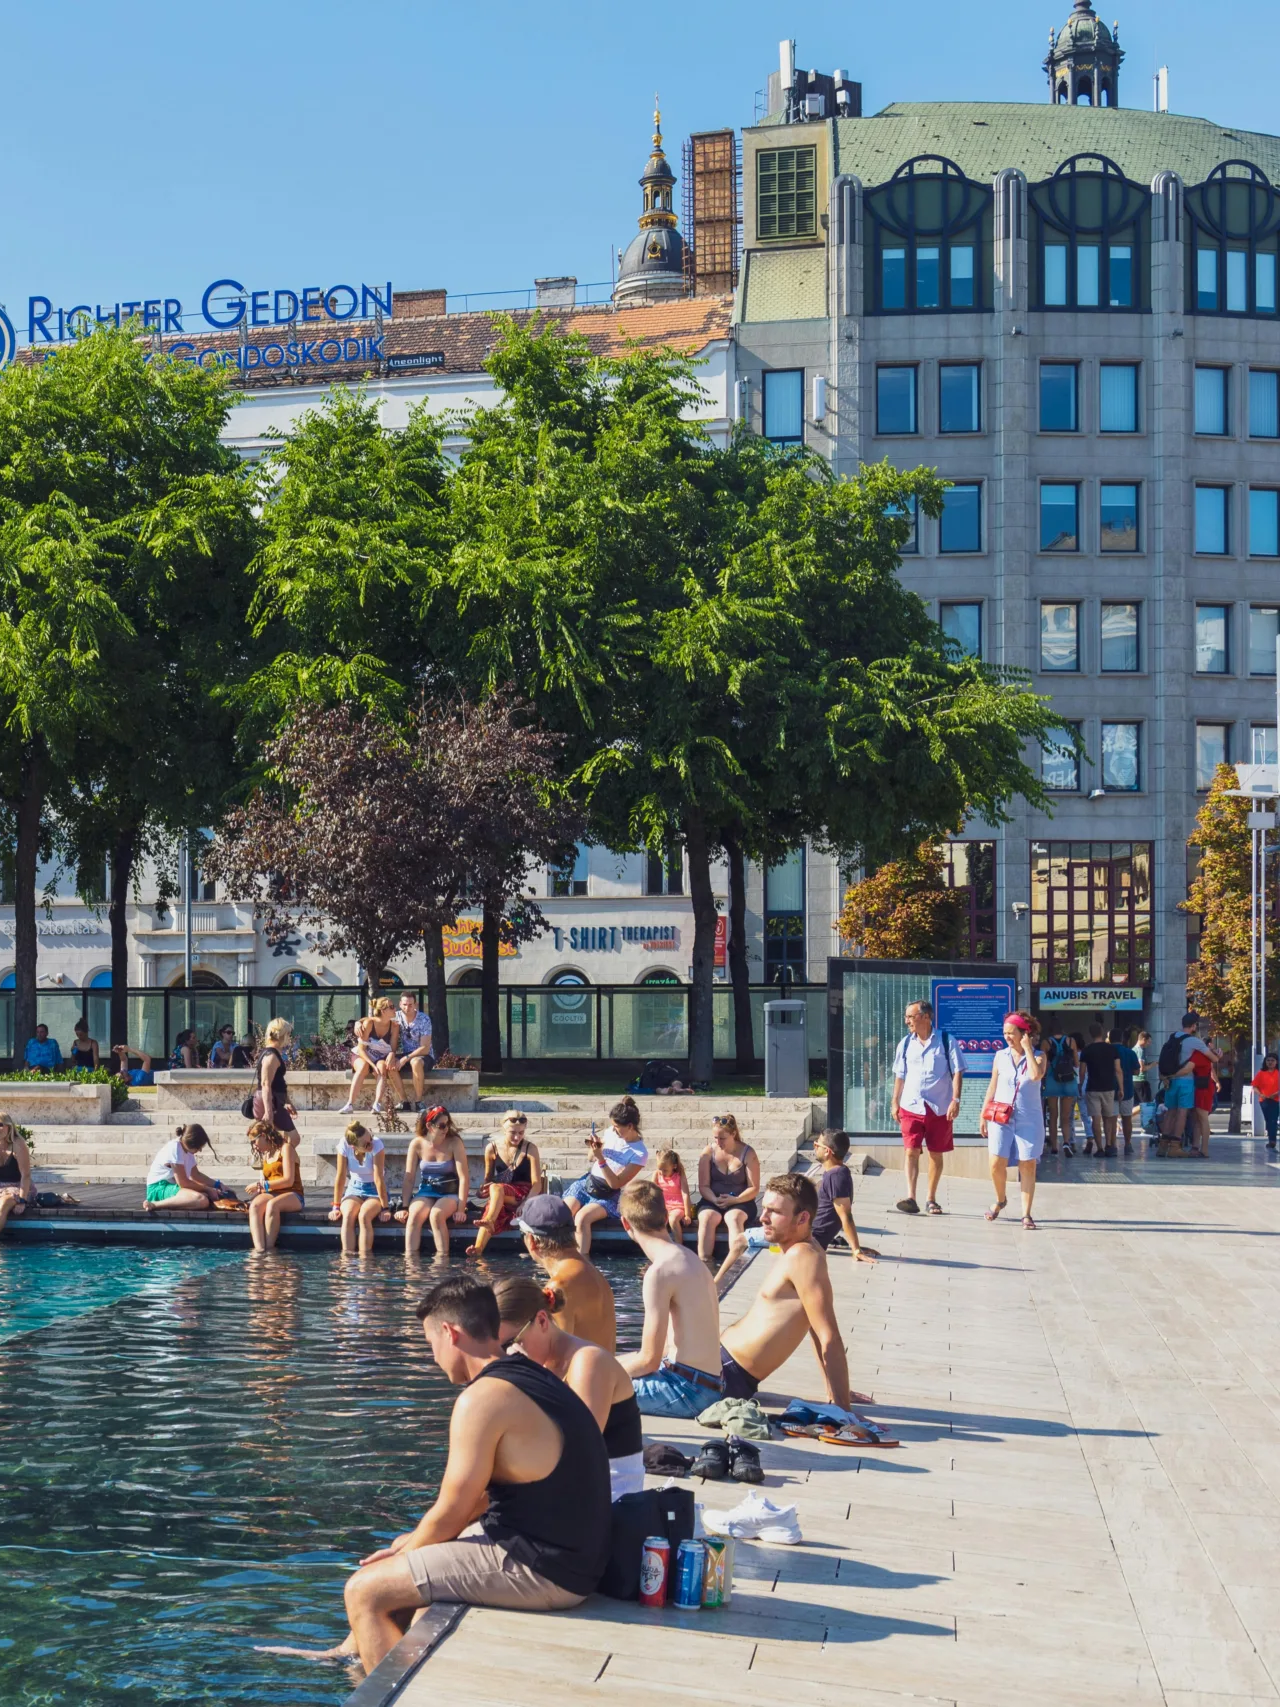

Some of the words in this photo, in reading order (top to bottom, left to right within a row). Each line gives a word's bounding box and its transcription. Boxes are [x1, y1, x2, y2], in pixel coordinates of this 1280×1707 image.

[202, 279, 392, 329] GEDEON
[394, 355, 443, 365] neonlight
[554, 926, 617, 950] T-SHIRT
[621, 925, 676, 941] THERAPIST
[1044, 990, 1088, 1000] ANUBIS
[1091, 990, 1137, 1000] TRAVEL
